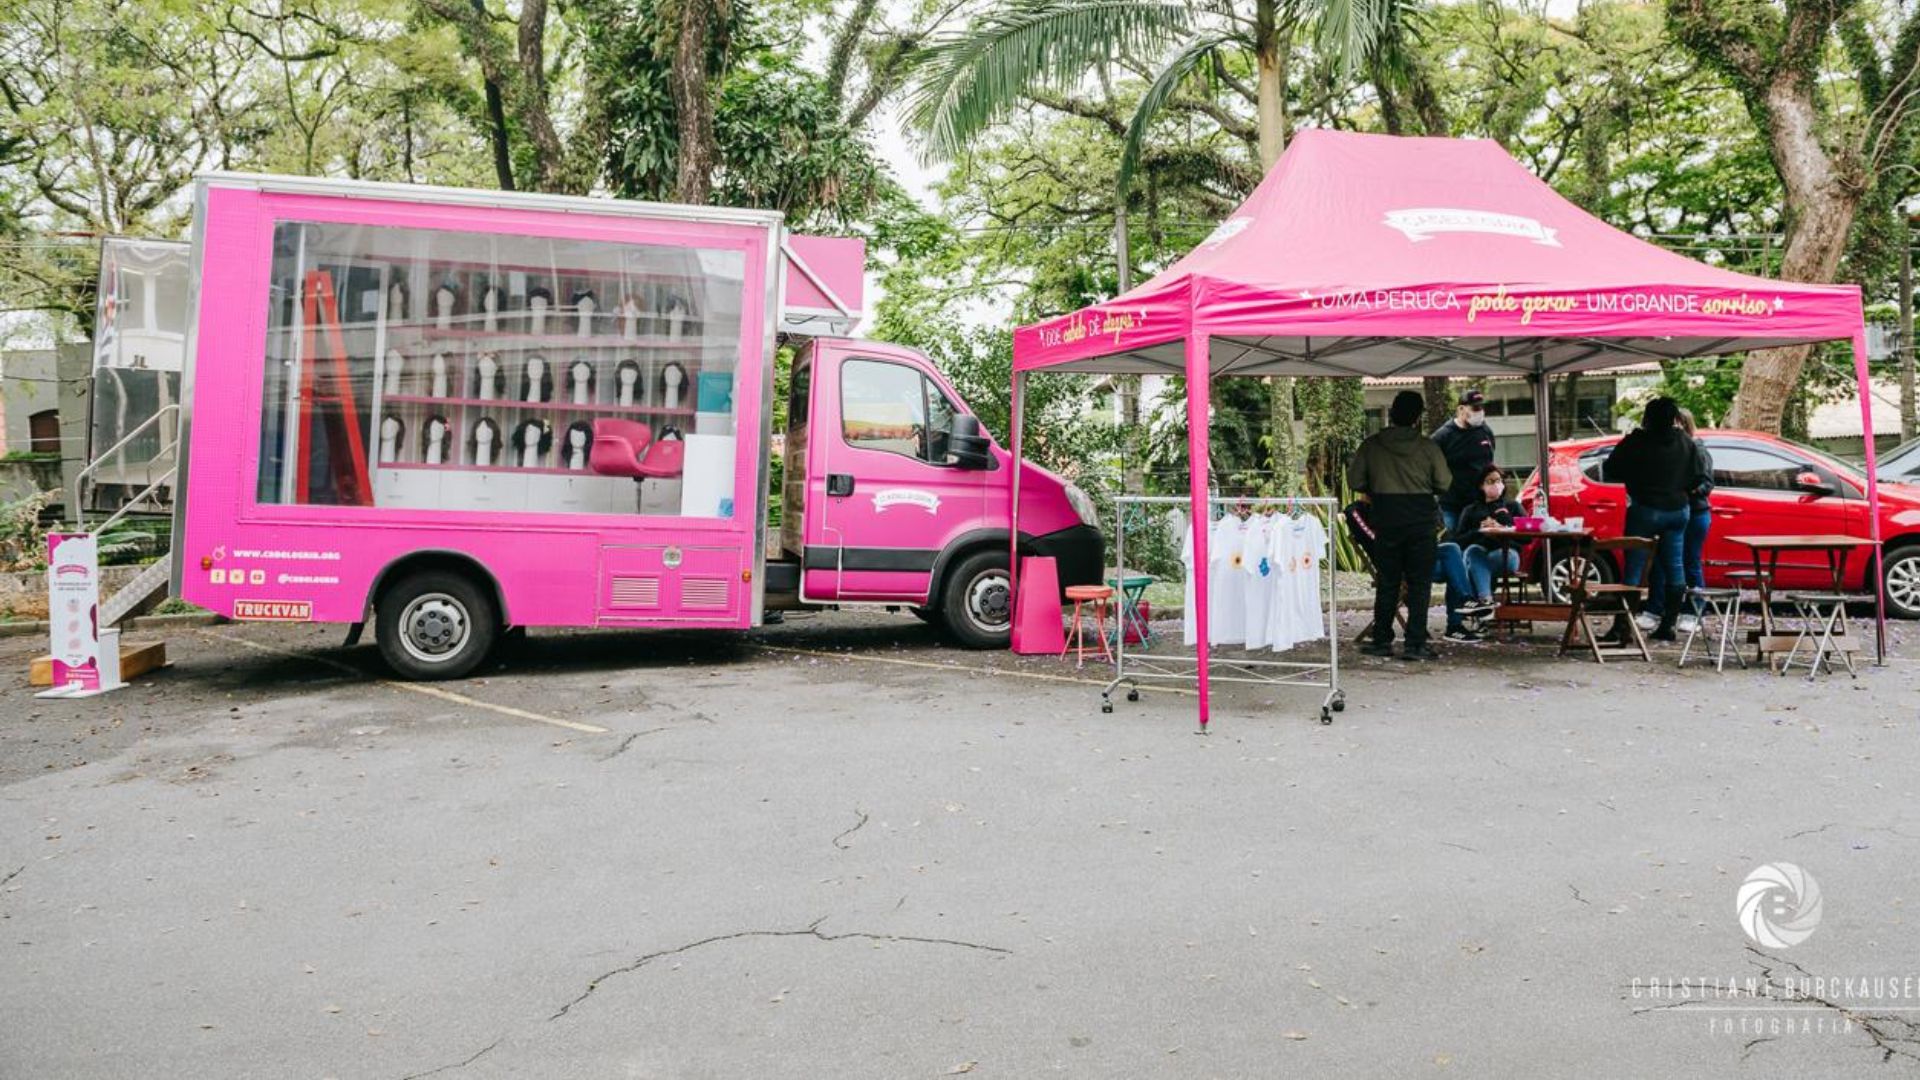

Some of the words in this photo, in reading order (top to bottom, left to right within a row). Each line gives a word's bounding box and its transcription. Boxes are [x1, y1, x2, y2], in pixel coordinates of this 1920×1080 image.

[1321, 290, 1371, 310] UMA
[1375, 290, 1461, 311] PERUCA
[1467, 285, 1518, 322] pode
[1520, 292, 1579, 325] gerar
[1587, 292, 1618, 312] UM
[1620, 292, 1699, 313] GRANDE
[236, 602, 309, 618] TRUCKVAN
